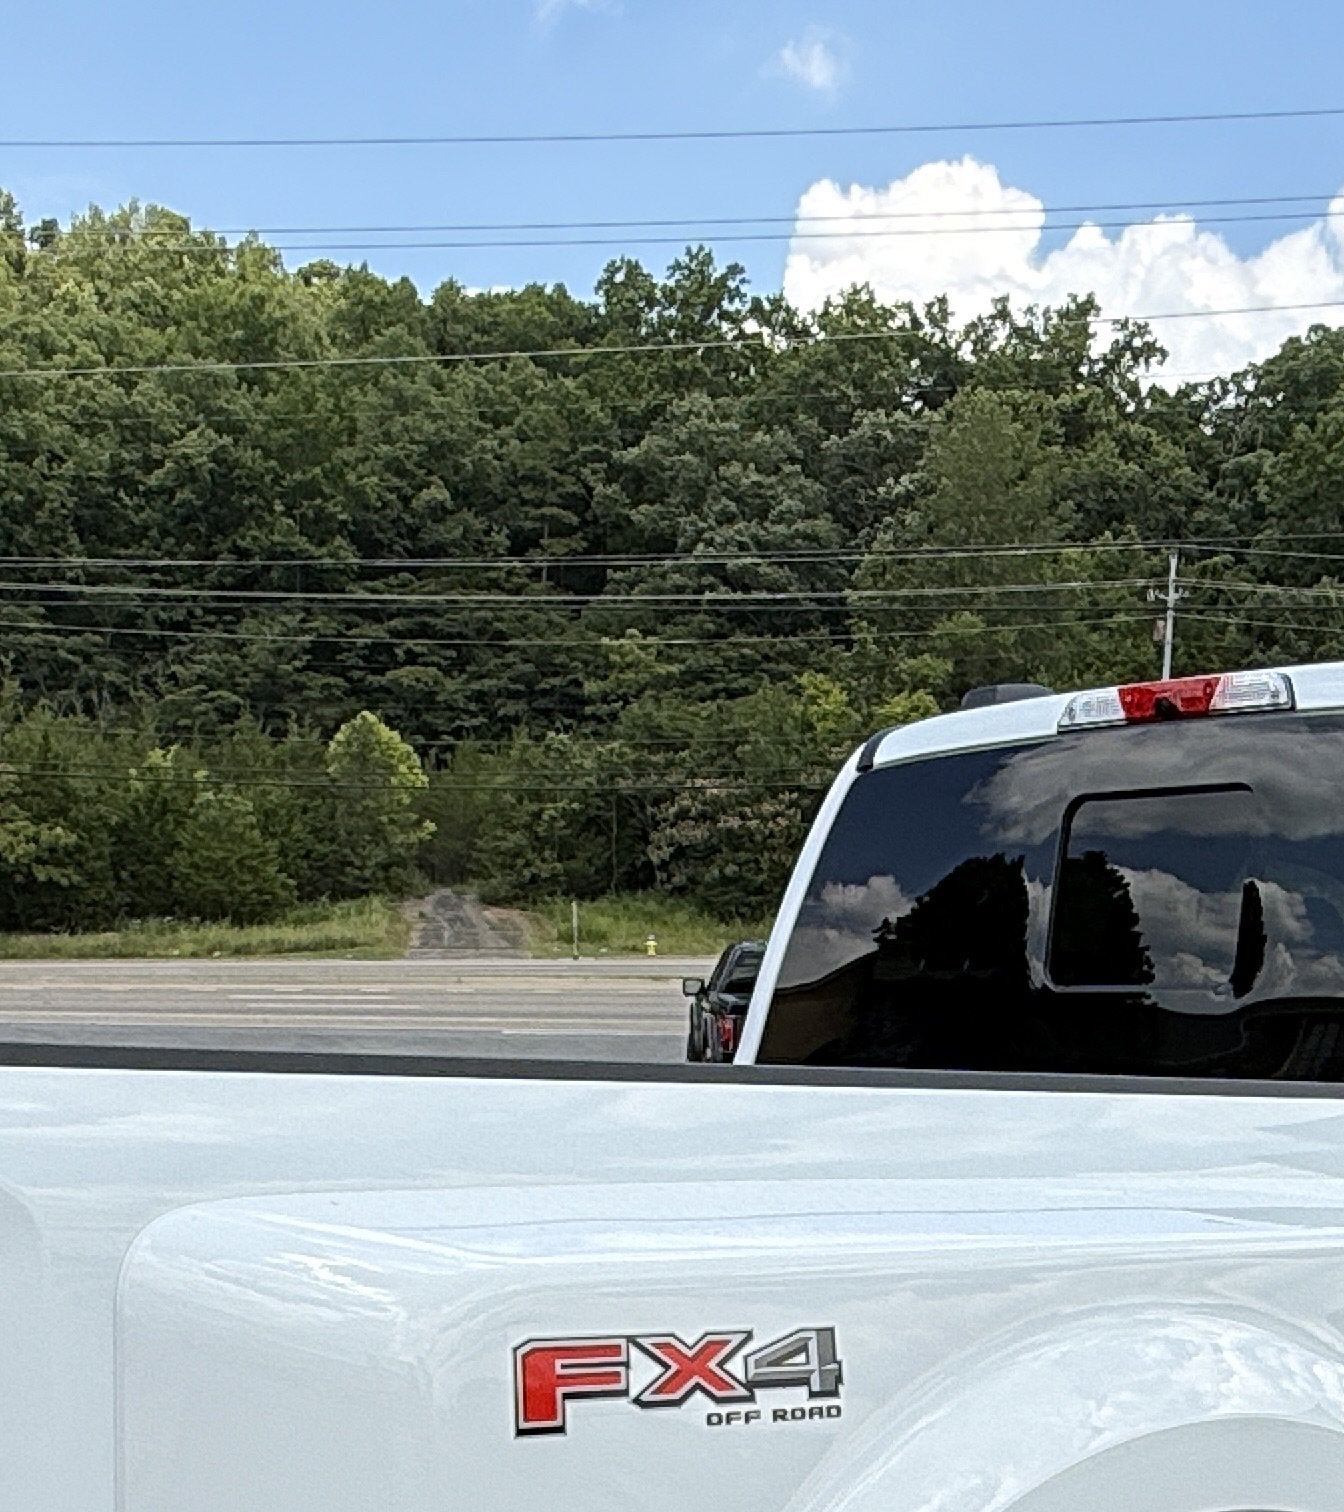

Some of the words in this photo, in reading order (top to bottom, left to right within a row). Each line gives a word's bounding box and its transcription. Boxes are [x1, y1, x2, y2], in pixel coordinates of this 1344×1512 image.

[513, 1326, 843, 1438] FX4
[706, 1410, 762, 1426] OFF
[772, 1404, 843, 1422] ROAD
